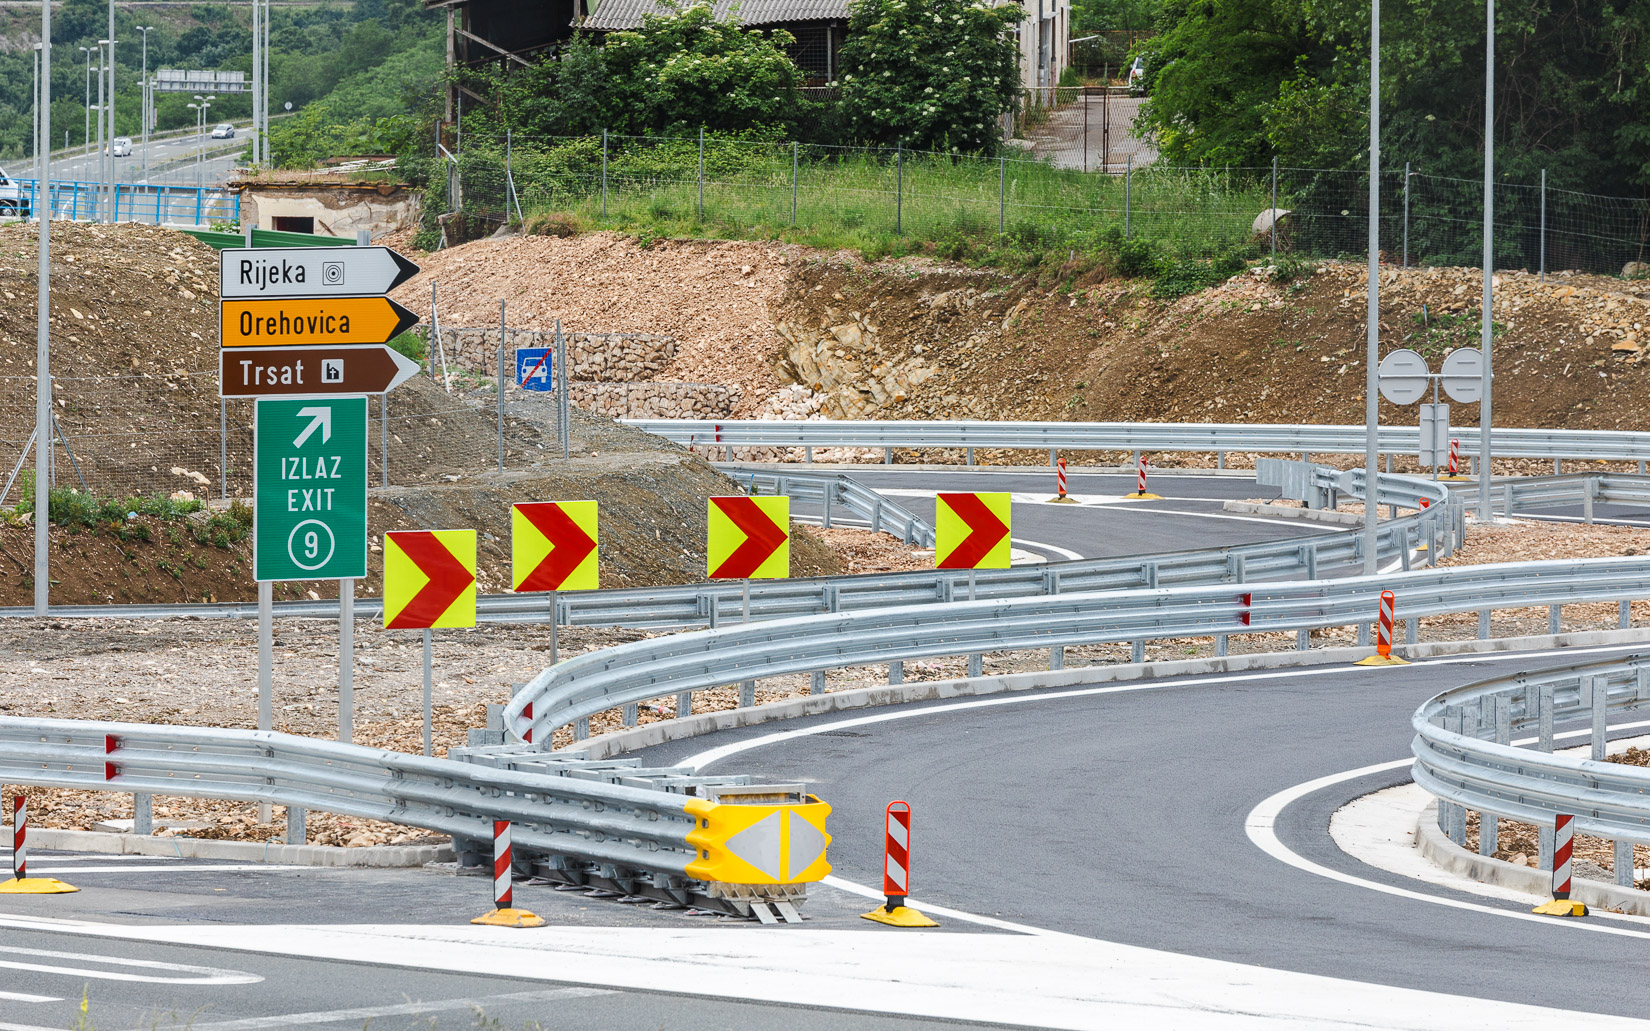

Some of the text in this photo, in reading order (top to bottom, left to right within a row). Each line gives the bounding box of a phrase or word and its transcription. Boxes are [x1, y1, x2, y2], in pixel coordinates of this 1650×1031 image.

[240, 259, 306, 290] Rijeka
[240, 310, 350, 336] Orehovica
[239, 360, 304, 386] Trsat
[281, 456, 342, 480] IZLAZ
[287, 488, 335, 512] EXIT
[304, 531, 319, 558] 9
